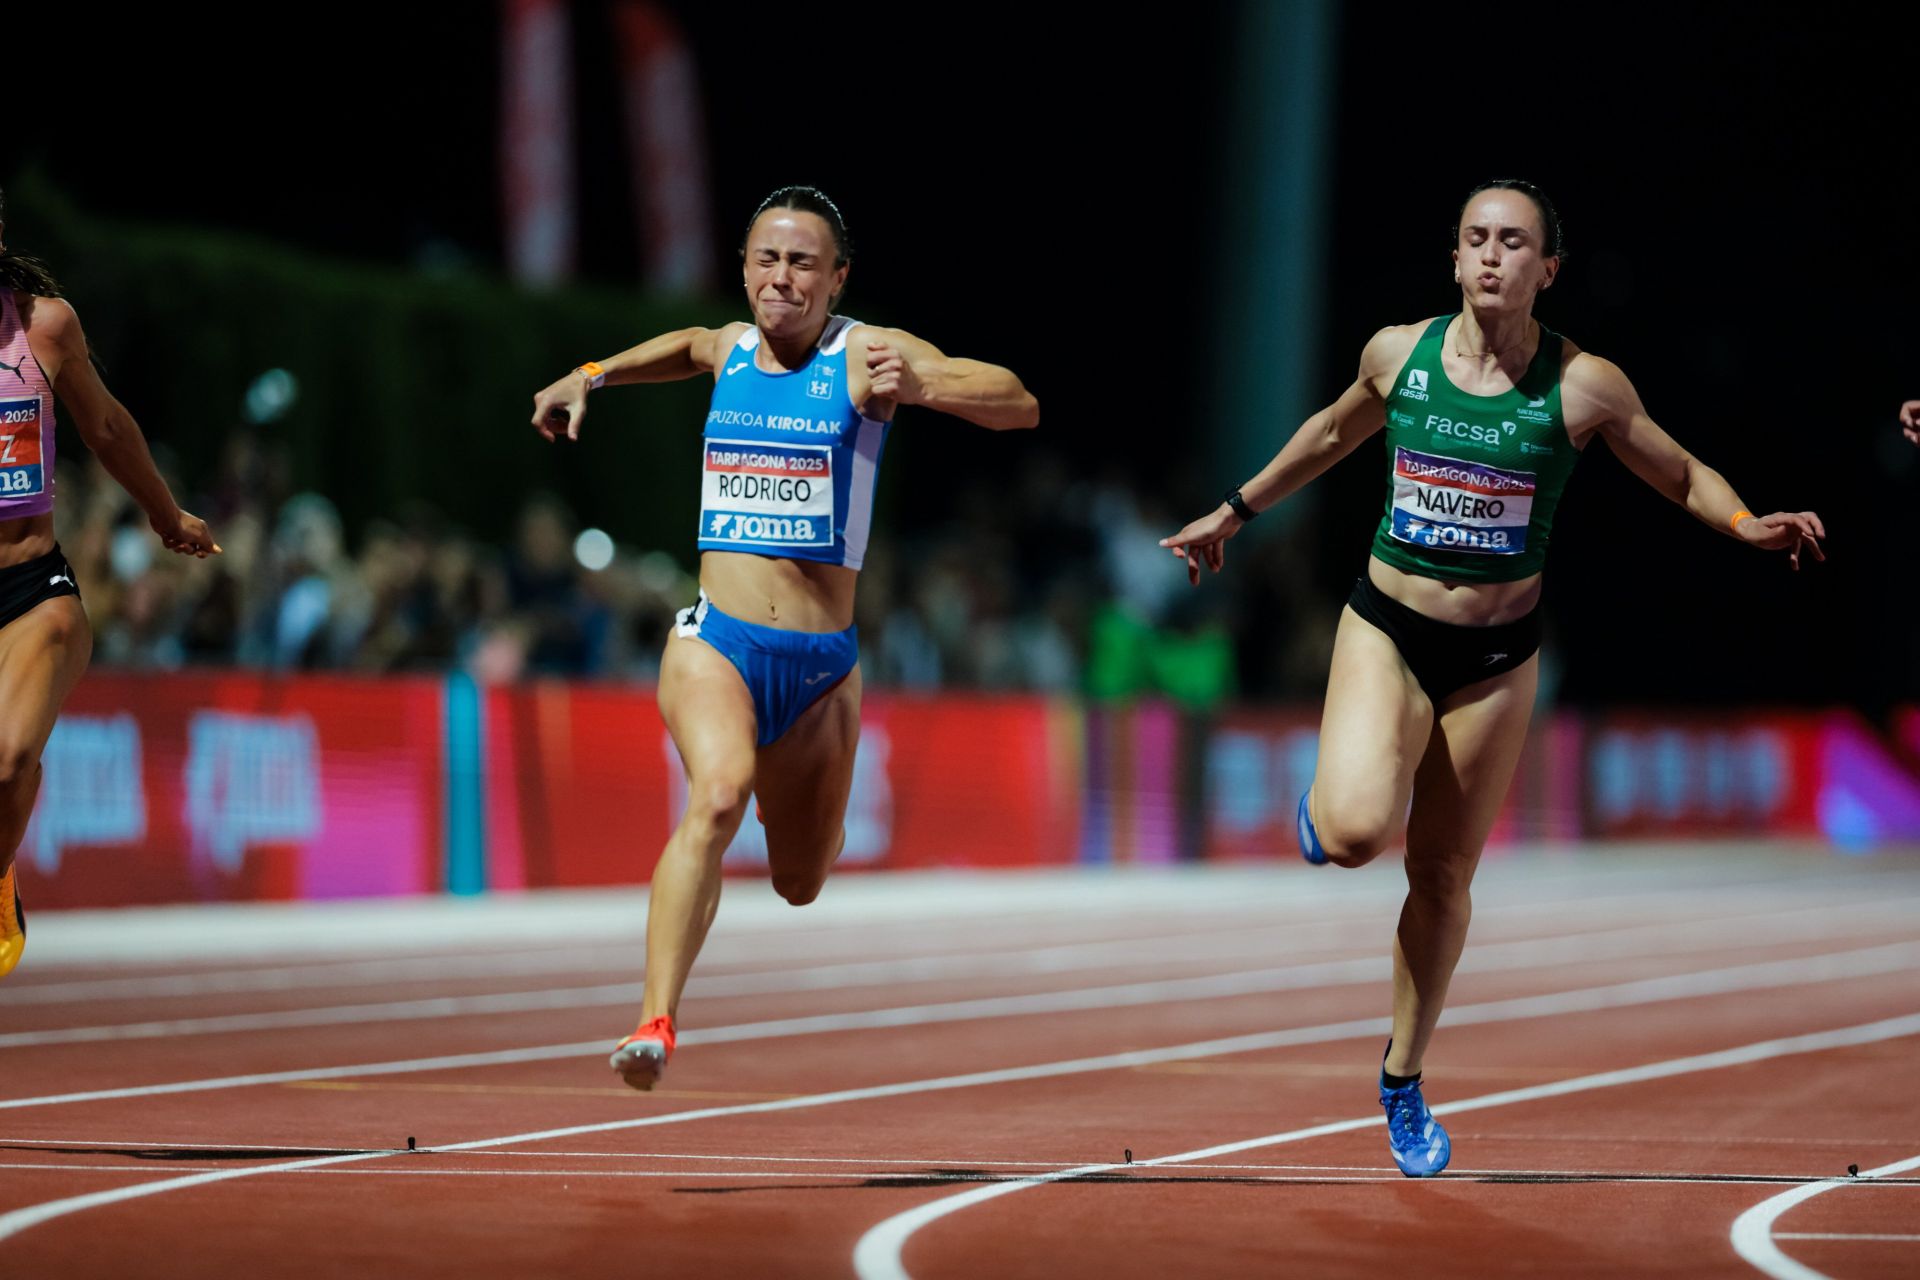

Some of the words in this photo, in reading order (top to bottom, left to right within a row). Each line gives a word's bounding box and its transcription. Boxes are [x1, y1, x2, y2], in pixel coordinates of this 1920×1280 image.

[5, 408, 36, 424] 2025
[766, 414, 842, 435] KIROLAK
[1424, 414, 1501, 446] Facsa
[710, 451, 788, 471] TARRAGONA
[788, 456, 824, 472] 2025
[1404, 459, 1491, 488] TARRAGONA
[719, 473, 811, 502] RODRIGO
[1417, 486, 1505, 519] NAVERO
